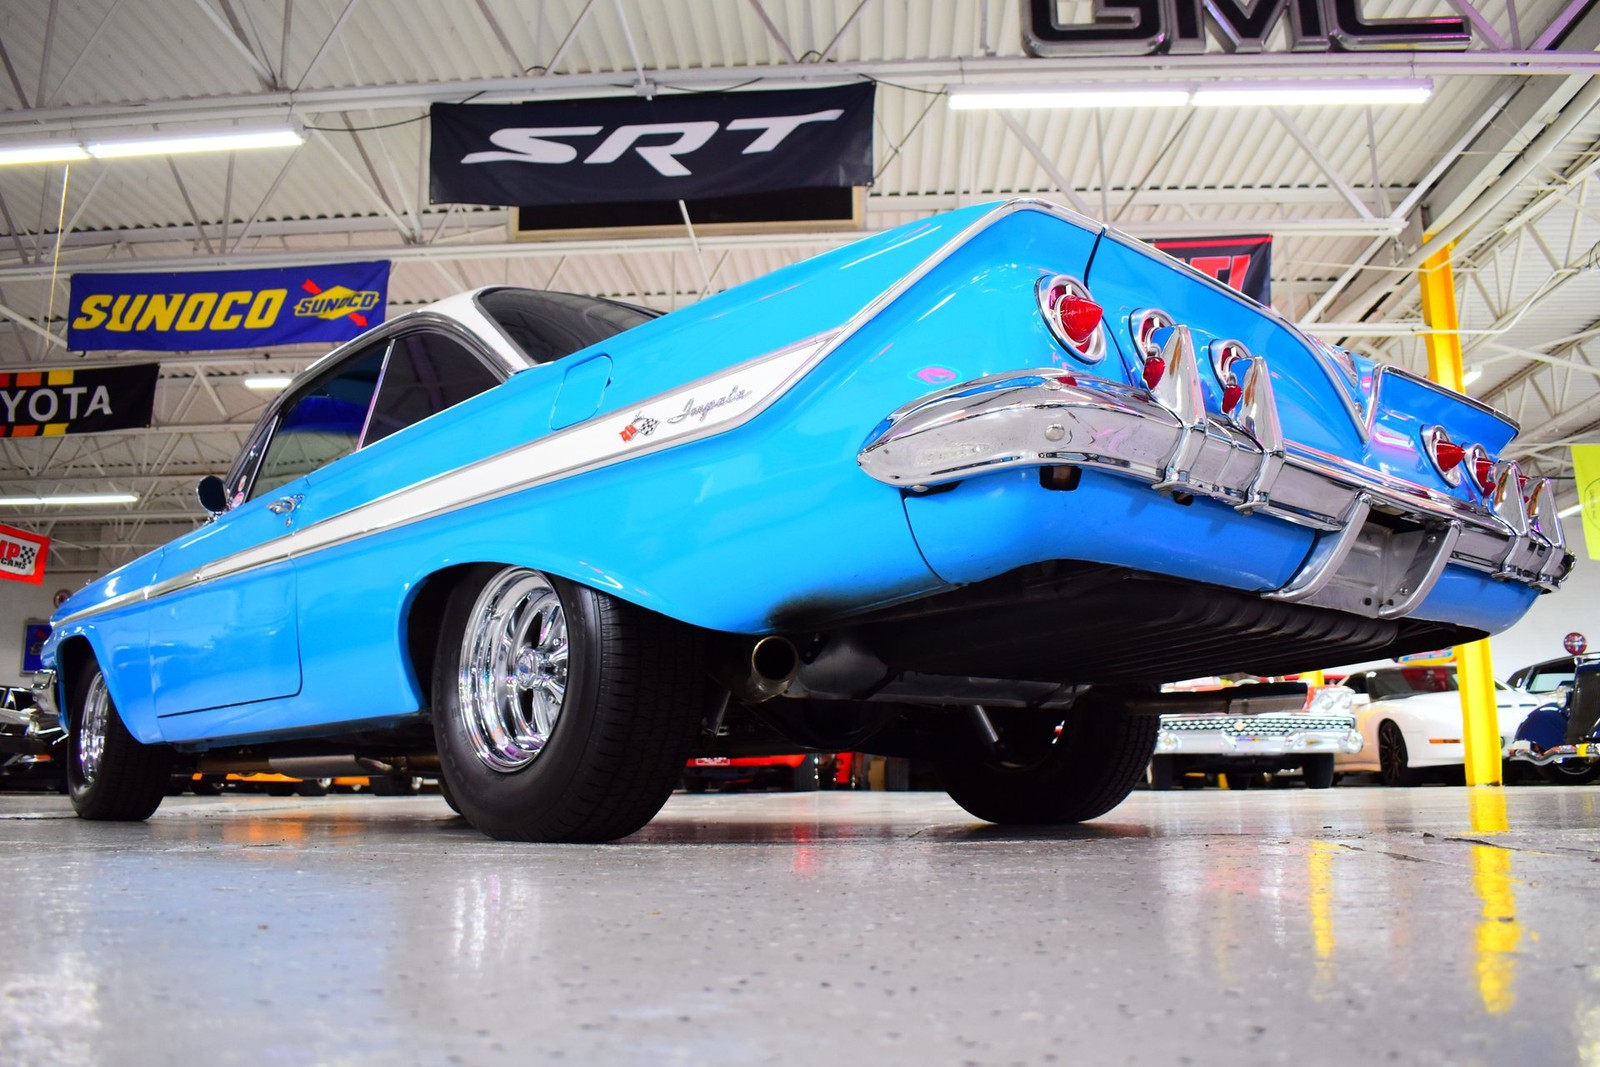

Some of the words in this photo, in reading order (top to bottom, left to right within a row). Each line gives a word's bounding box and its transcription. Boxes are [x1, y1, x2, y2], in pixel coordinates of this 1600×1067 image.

[460, 108, 845, 177] SRT
[72, 288, 288, 332] SUNOCO
[297, 293, 376, 314] SUNOCO
[0, 385, 113, 422] YOTA
[667, 385, 752, 423] Impala
[0, 557, 27, 570] CAMS
